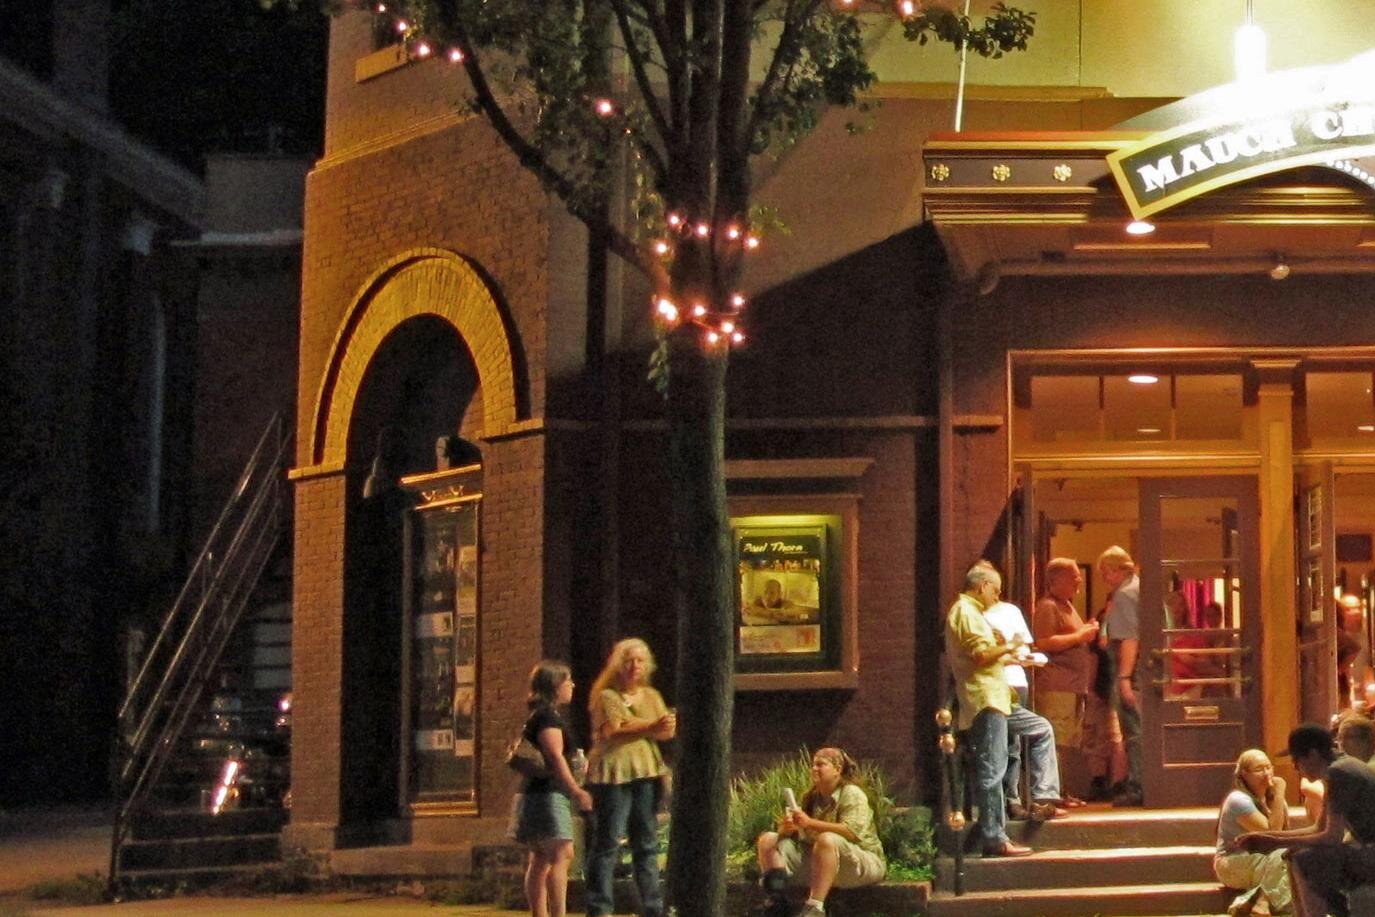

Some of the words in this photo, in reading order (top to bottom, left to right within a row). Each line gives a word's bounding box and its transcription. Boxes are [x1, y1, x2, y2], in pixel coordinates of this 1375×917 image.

[1137, 119, 1297, 193] MAUCH
[743, 542, 768, 553] Paul
[770, 541, 803, 552] Thorn
